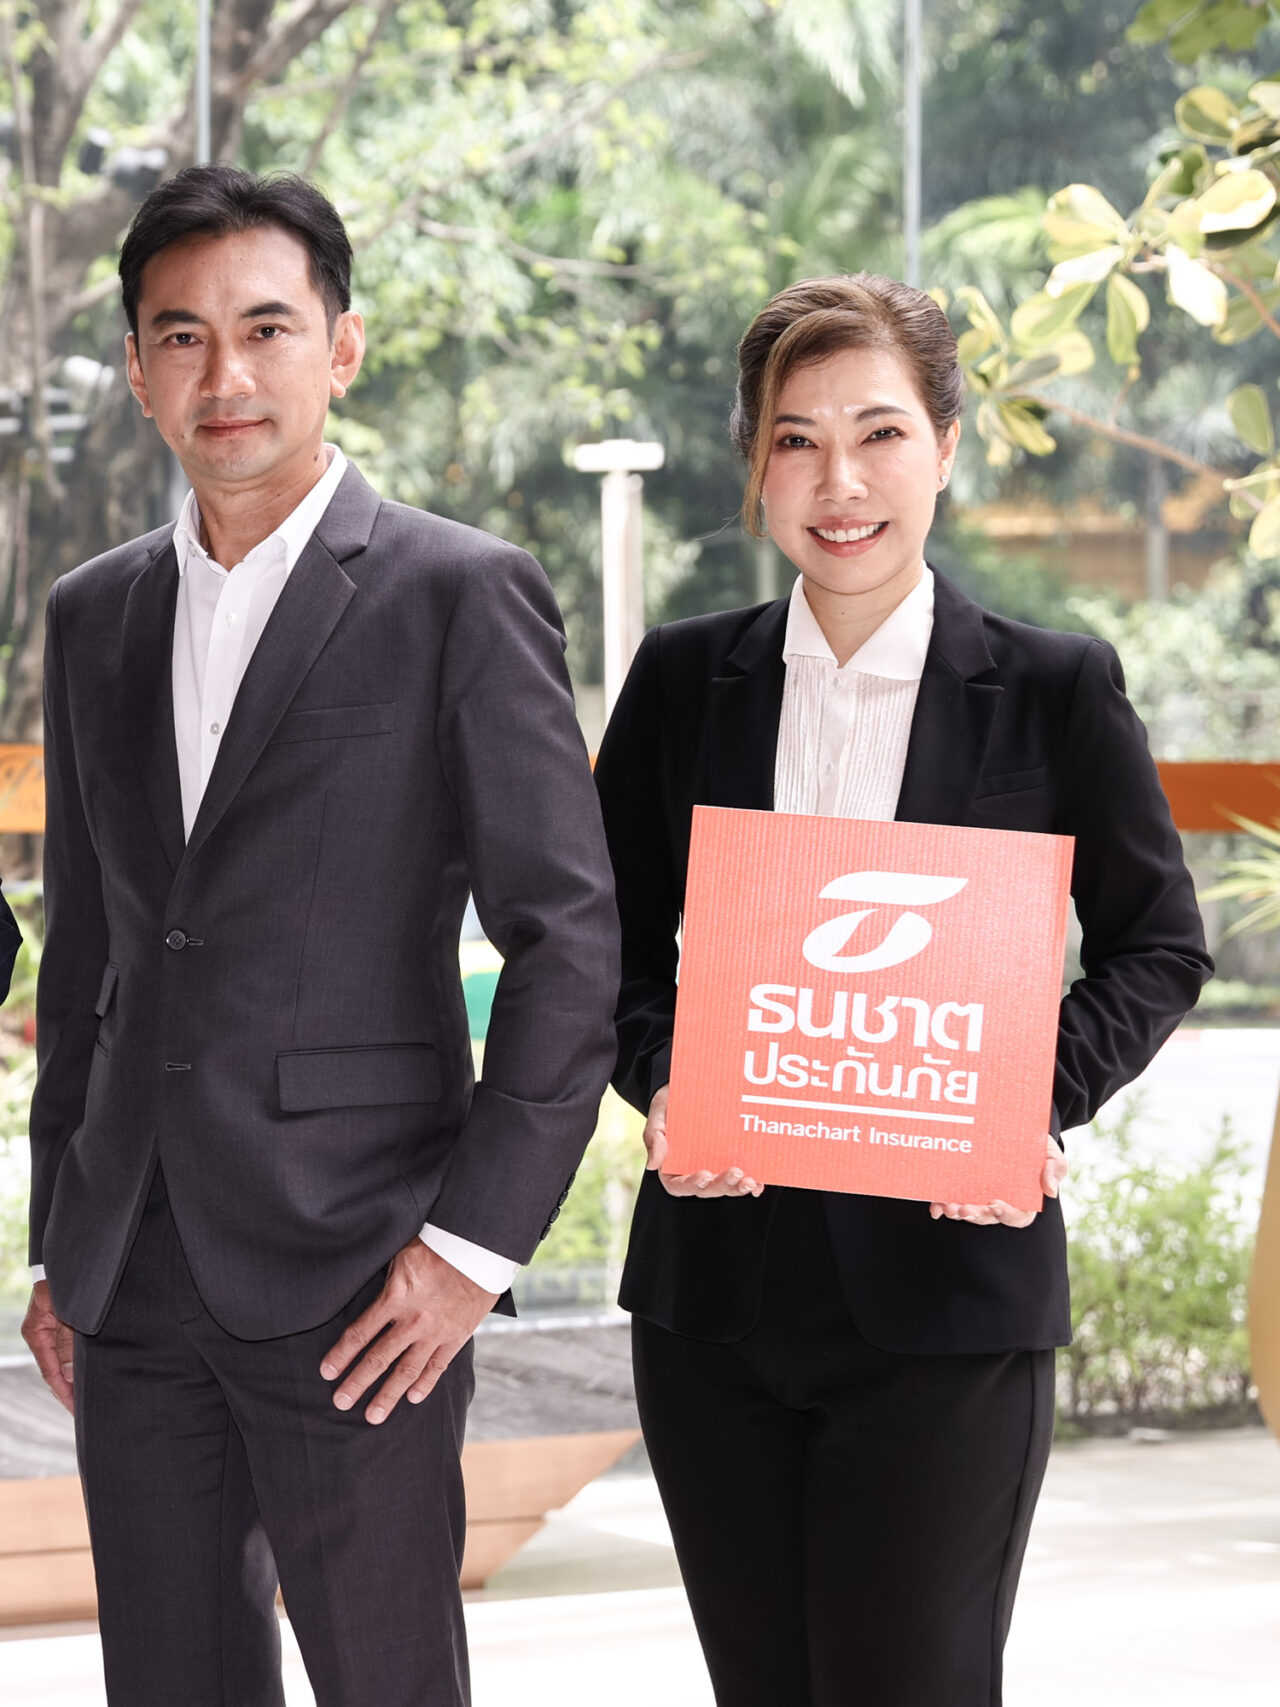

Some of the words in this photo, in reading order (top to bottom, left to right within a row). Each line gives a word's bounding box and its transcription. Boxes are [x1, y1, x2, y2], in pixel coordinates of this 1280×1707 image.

[747, 983, 984, 1052] ธนชาต
[743, 1042, 978, 1105] ประกันภัย
[740, 1114, 861, 1143] Thanachart
[869, 1126, 972, 1153] Insurance
